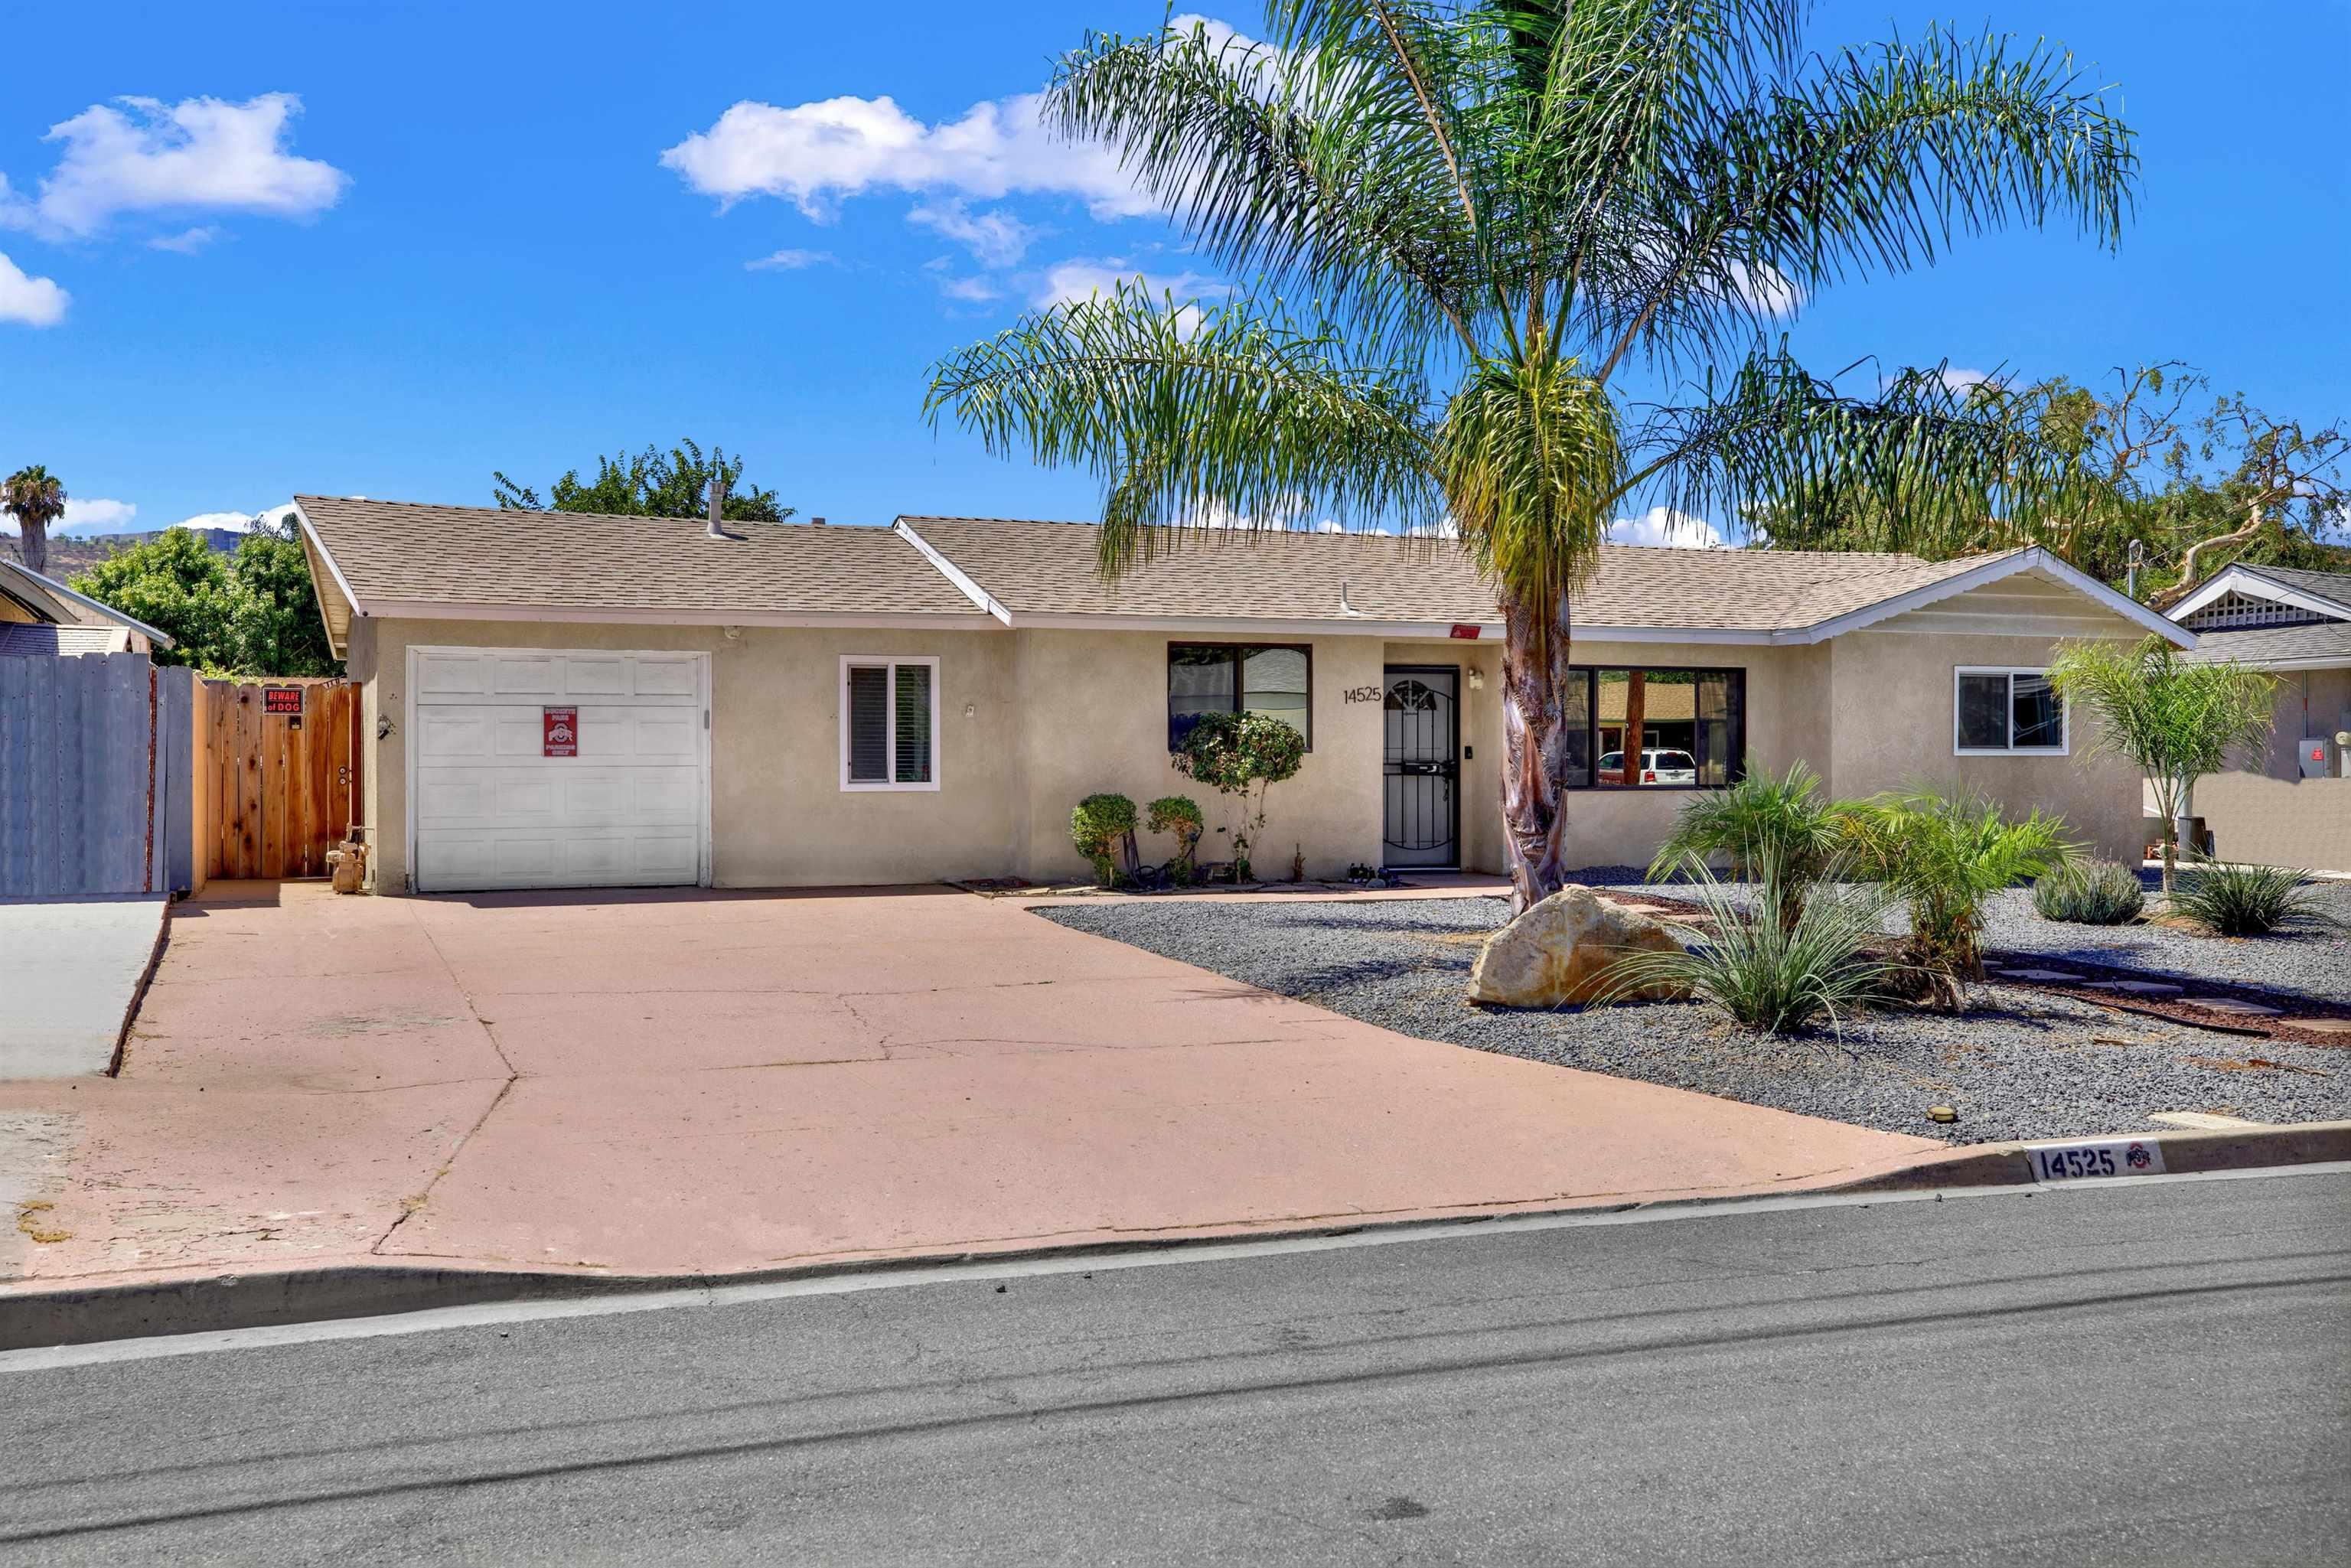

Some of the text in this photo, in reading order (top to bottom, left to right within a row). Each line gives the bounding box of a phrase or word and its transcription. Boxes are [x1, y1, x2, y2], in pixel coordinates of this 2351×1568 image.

[269, 691, 300, 700] BEWARE
[1344, 686, 1382, 704] 14525
[2040, 1149, 2115, 1179] 14525
